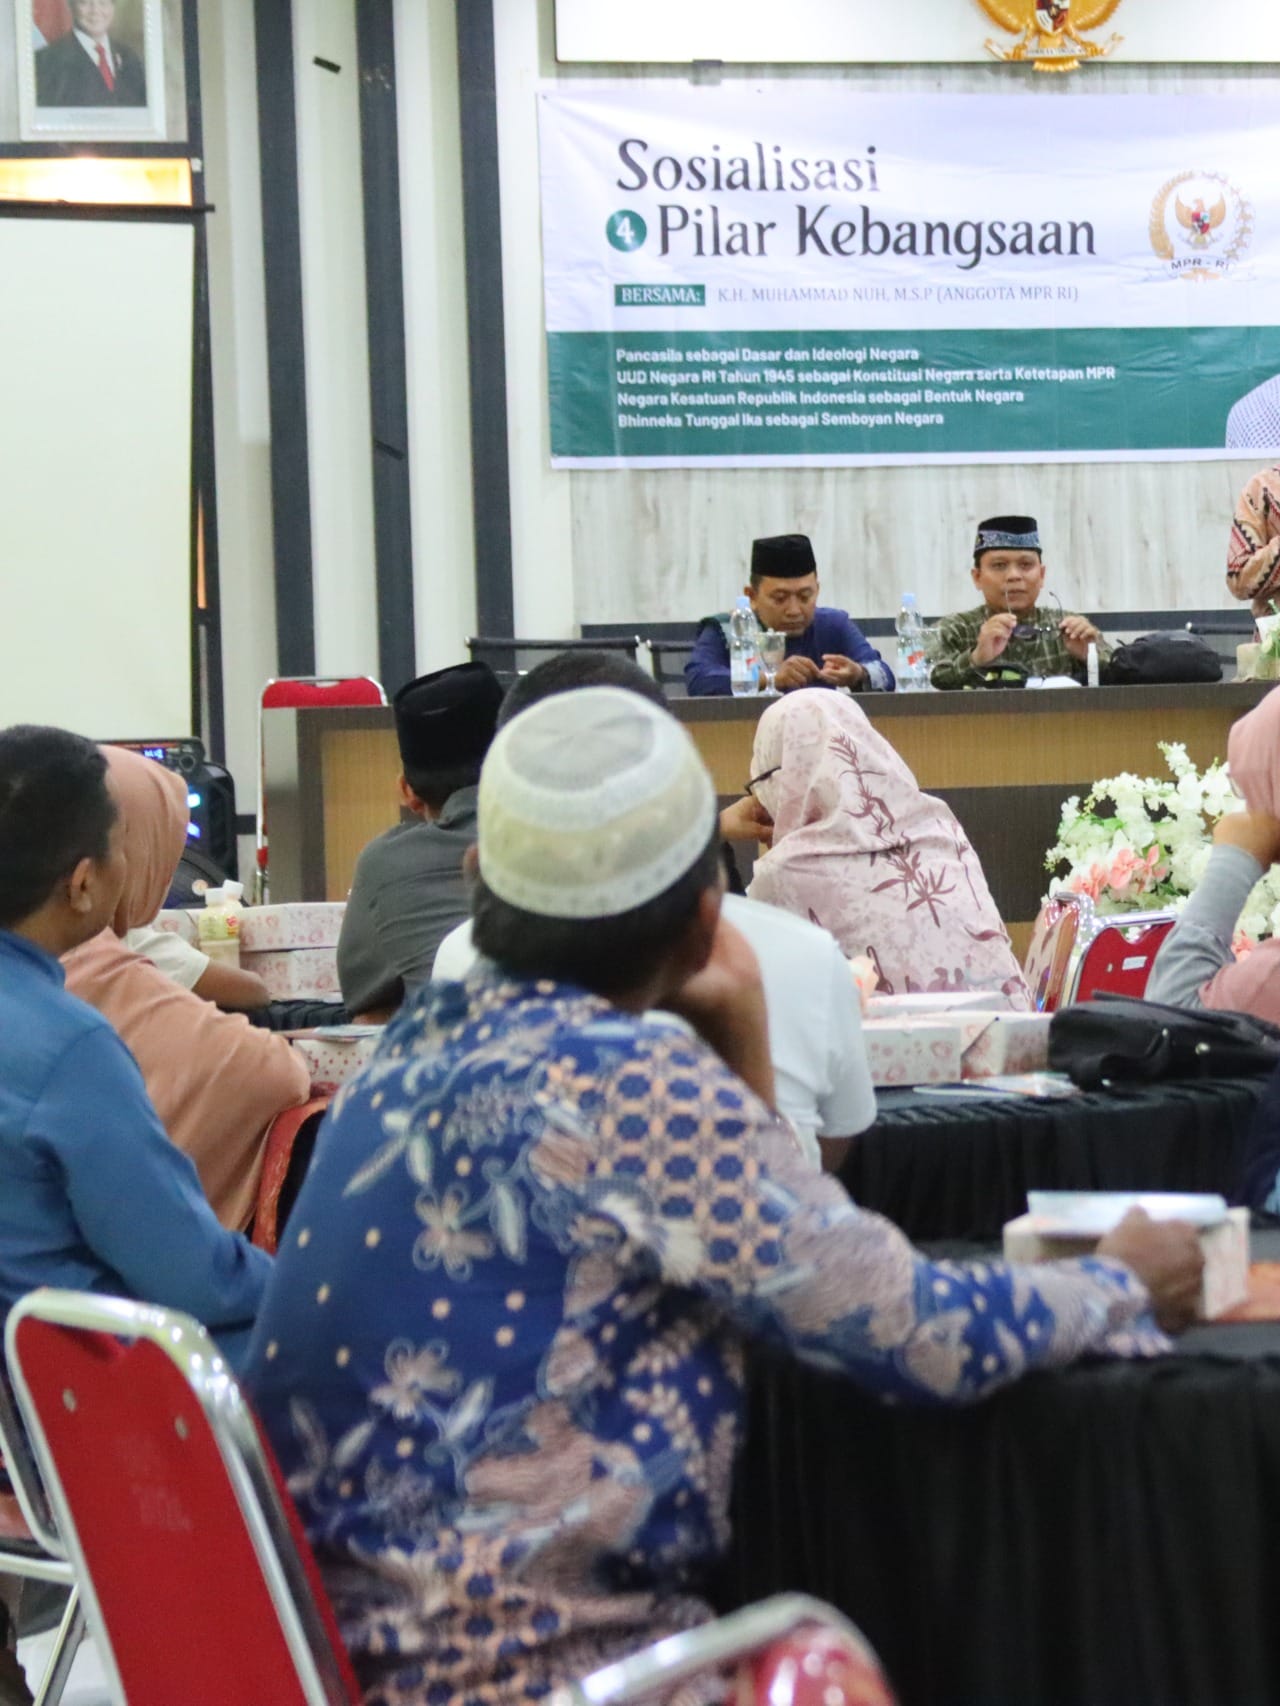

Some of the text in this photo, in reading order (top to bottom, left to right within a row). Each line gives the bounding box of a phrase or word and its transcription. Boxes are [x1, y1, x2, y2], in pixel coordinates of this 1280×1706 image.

[617, 138, 881, 192] Sosialisasi
[616, 203, 1097, 271] 4 Pilar Kebangsaan
[1170, 257, 1202, 270] MPR
[621, 285, 1080, 304] BERSAMA: K.H. MUHAMMAD NUH, M.S.P (ANGGOTA MPR RI)
[616, 346, 920, 365] Pancasila sebagai Dasar dan Ideologi Negara
[616, 366, 1116, 387] UUD Negara RI Tahun 1945 sebagai Konstitusi Negara serta Ketetapan MPR
[617, 389, 1025, 409] Negara Kesatuan Republik Indonesia sebagai Bentuk Negara
[618, 411, 945, 430] Bhinneka Tunggal Ika sebagai Semboyan Negara
